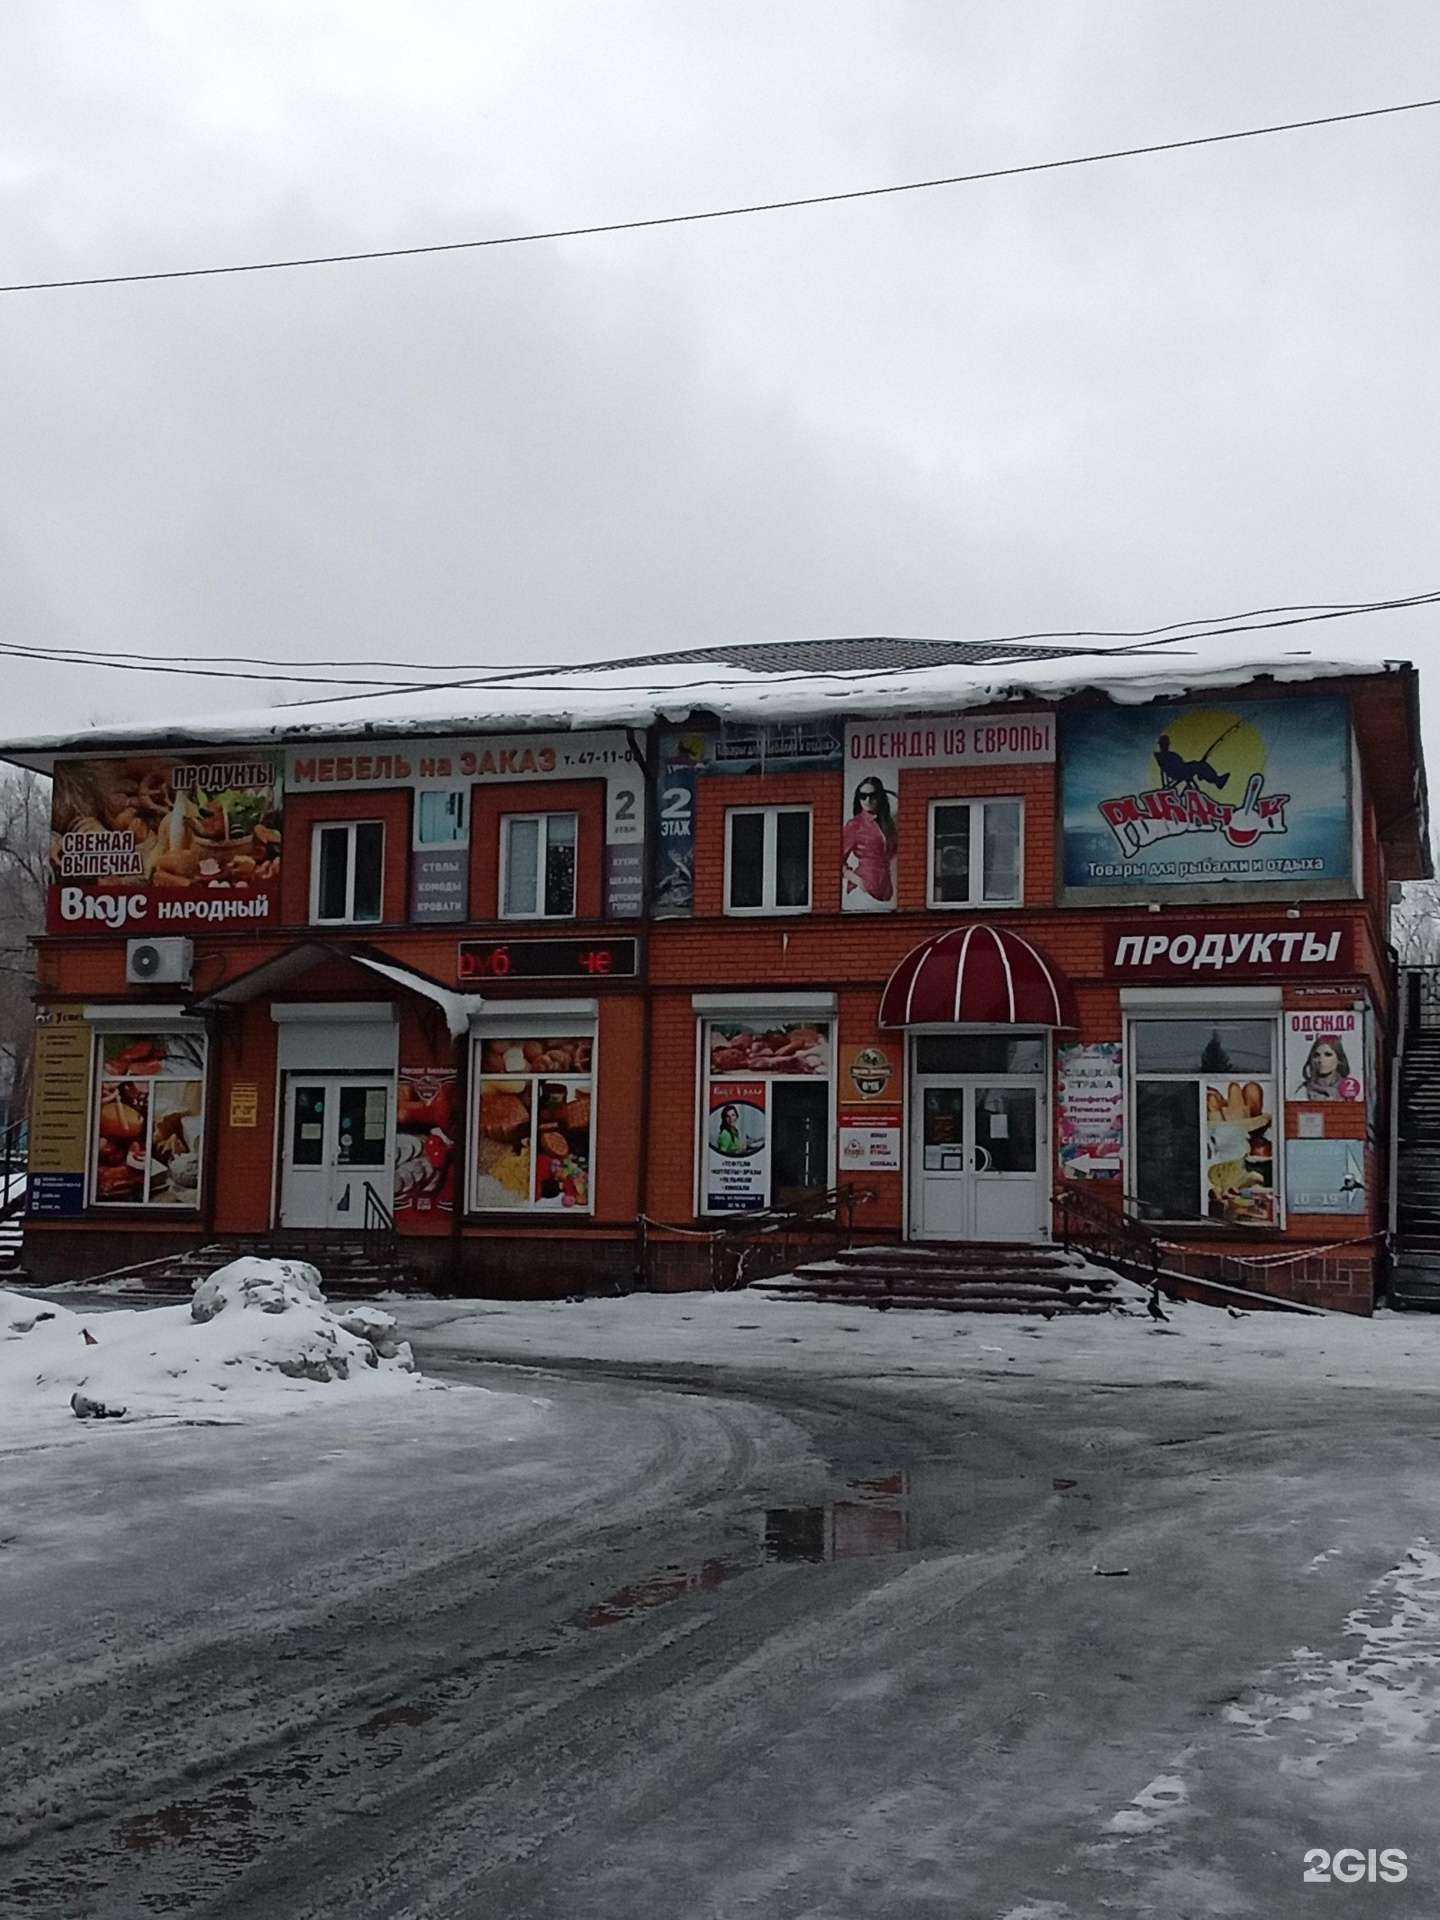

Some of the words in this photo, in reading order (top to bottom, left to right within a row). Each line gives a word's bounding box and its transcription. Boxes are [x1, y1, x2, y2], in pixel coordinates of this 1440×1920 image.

[851, 731, 936, 760] ОДЕЖДА
[944, 729, 966, 755] ИЗ
[974, 725, 1049, 753] ЕВРОПЫ
[172, 763, 277, 791] ПРОДУКТЫ
[294, 755, 411, 783] МЕБЕЛЬ
[460, 748, 557, 777] ЗАКАЗ
[615, 790, 636, 821] 2
[661, 787, 692, 819] 2
[661, 821, 691, 836] ЭТАЖ
[63, 831, 134, 853] СВЕЖАЯ
[61, 853, 143, 877] ВЫПЕЧКА
[422, 861, 460, 872] СТОЛЫ
[1088, 862, 1145, 877] Товары
[1149, 860, 1175, 876] для
[1179, 857, 1249, 877] рыбалки
[1252, 860, 1263, 872] и
[1267, 857, 1324, 874] отдыха
[60, 887, 147, 927] Вкус
[158, 895, 269, 922] НАРОДНЫЙ
[417, 900, 462, 911] КРОВАТИ
[1114, 932, 1342, 970] ПРОДУКТЫ
[1291, 1015, 1355, 1031] ОДЕЖДА
[1344, 1080, 1355, 1091] 2
